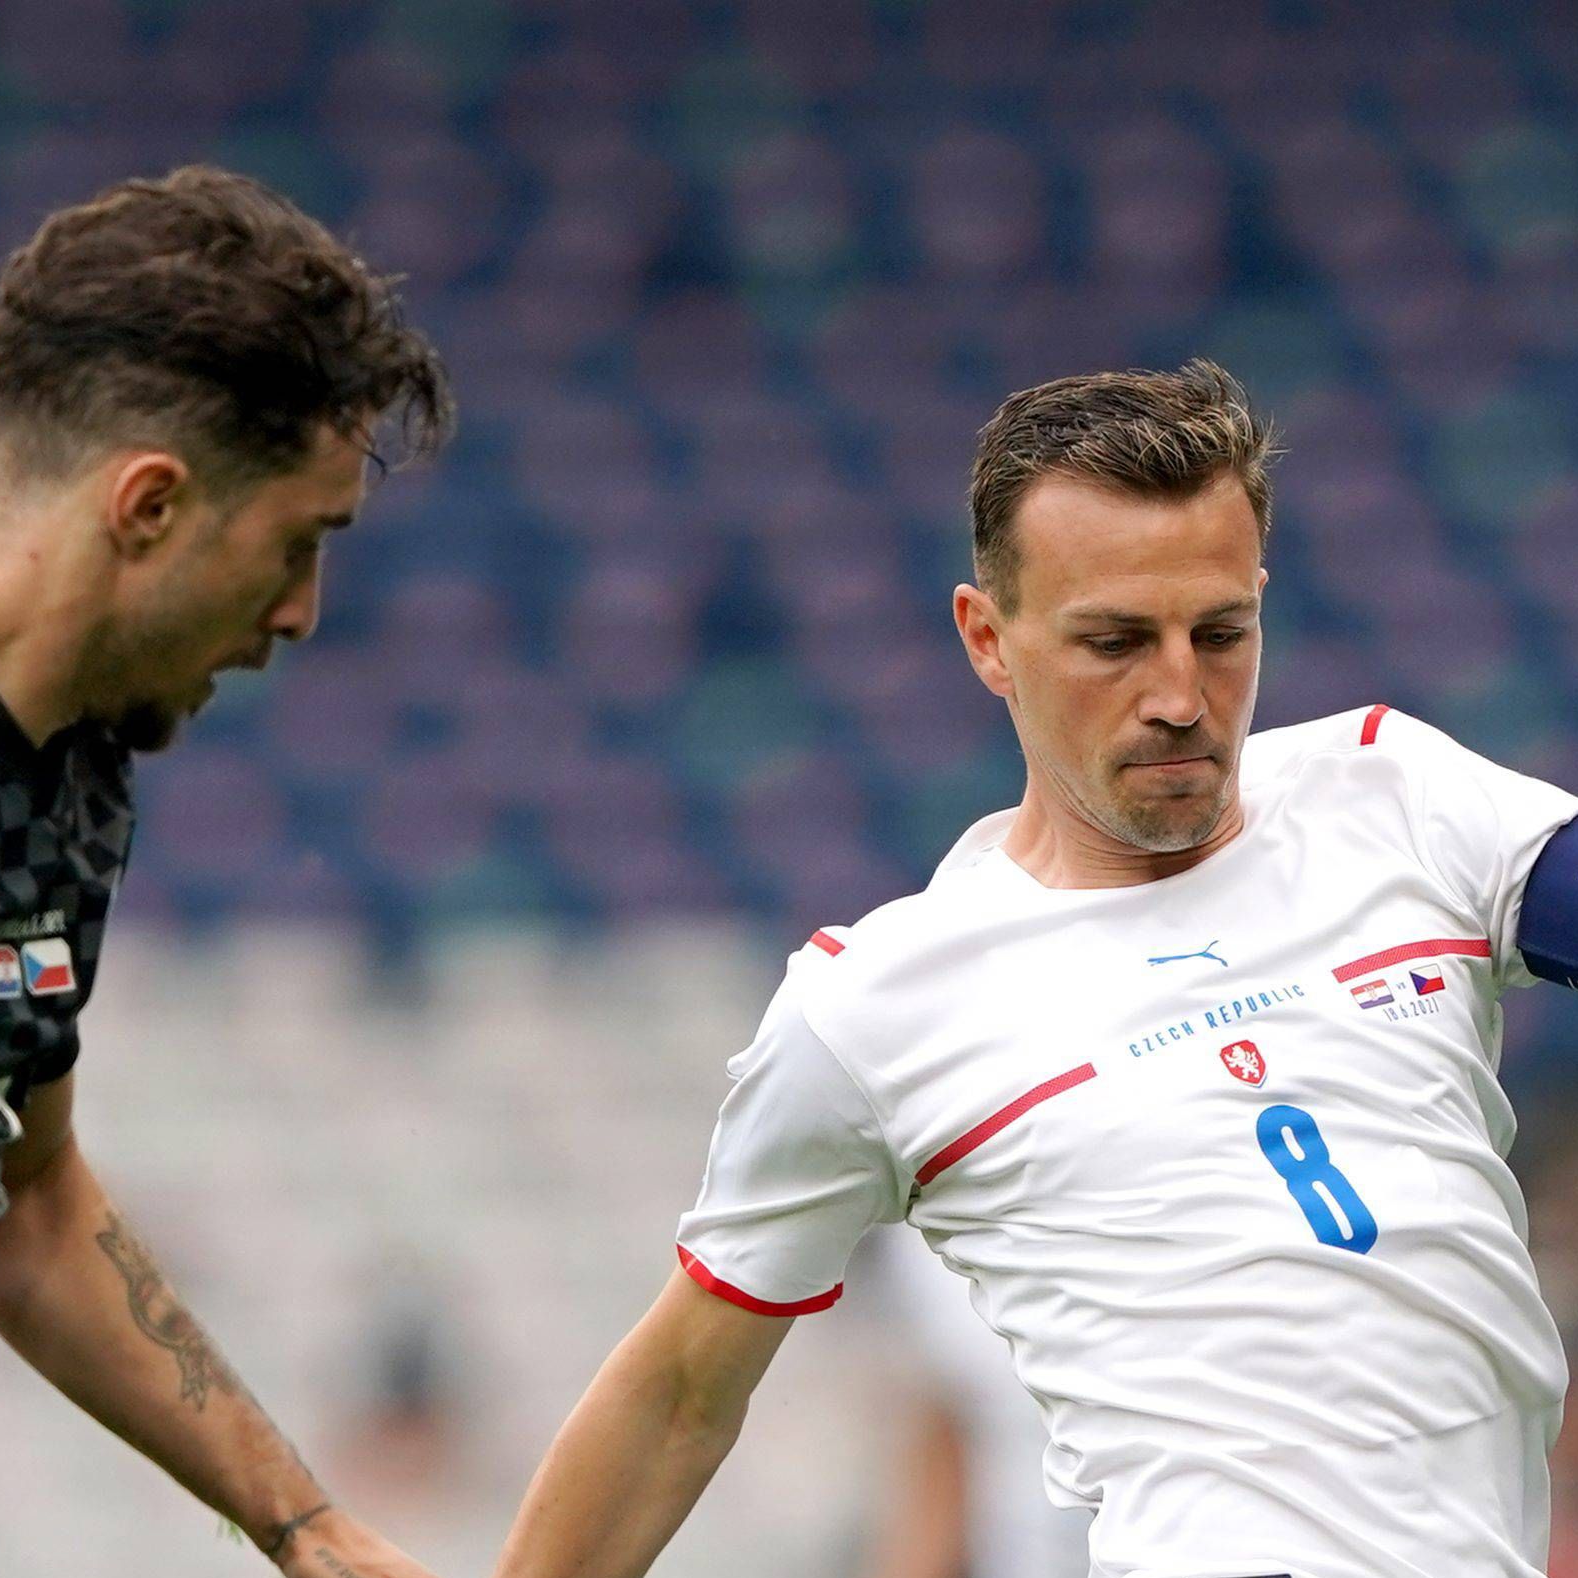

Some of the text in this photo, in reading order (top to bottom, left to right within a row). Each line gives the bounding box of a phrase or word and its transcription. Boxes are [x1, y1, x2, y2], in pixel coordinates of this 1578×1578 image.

[1129, 984, 1306, 1058] CZECH REPUBLIC
[1256, 1104, 1378, 1255] 8
